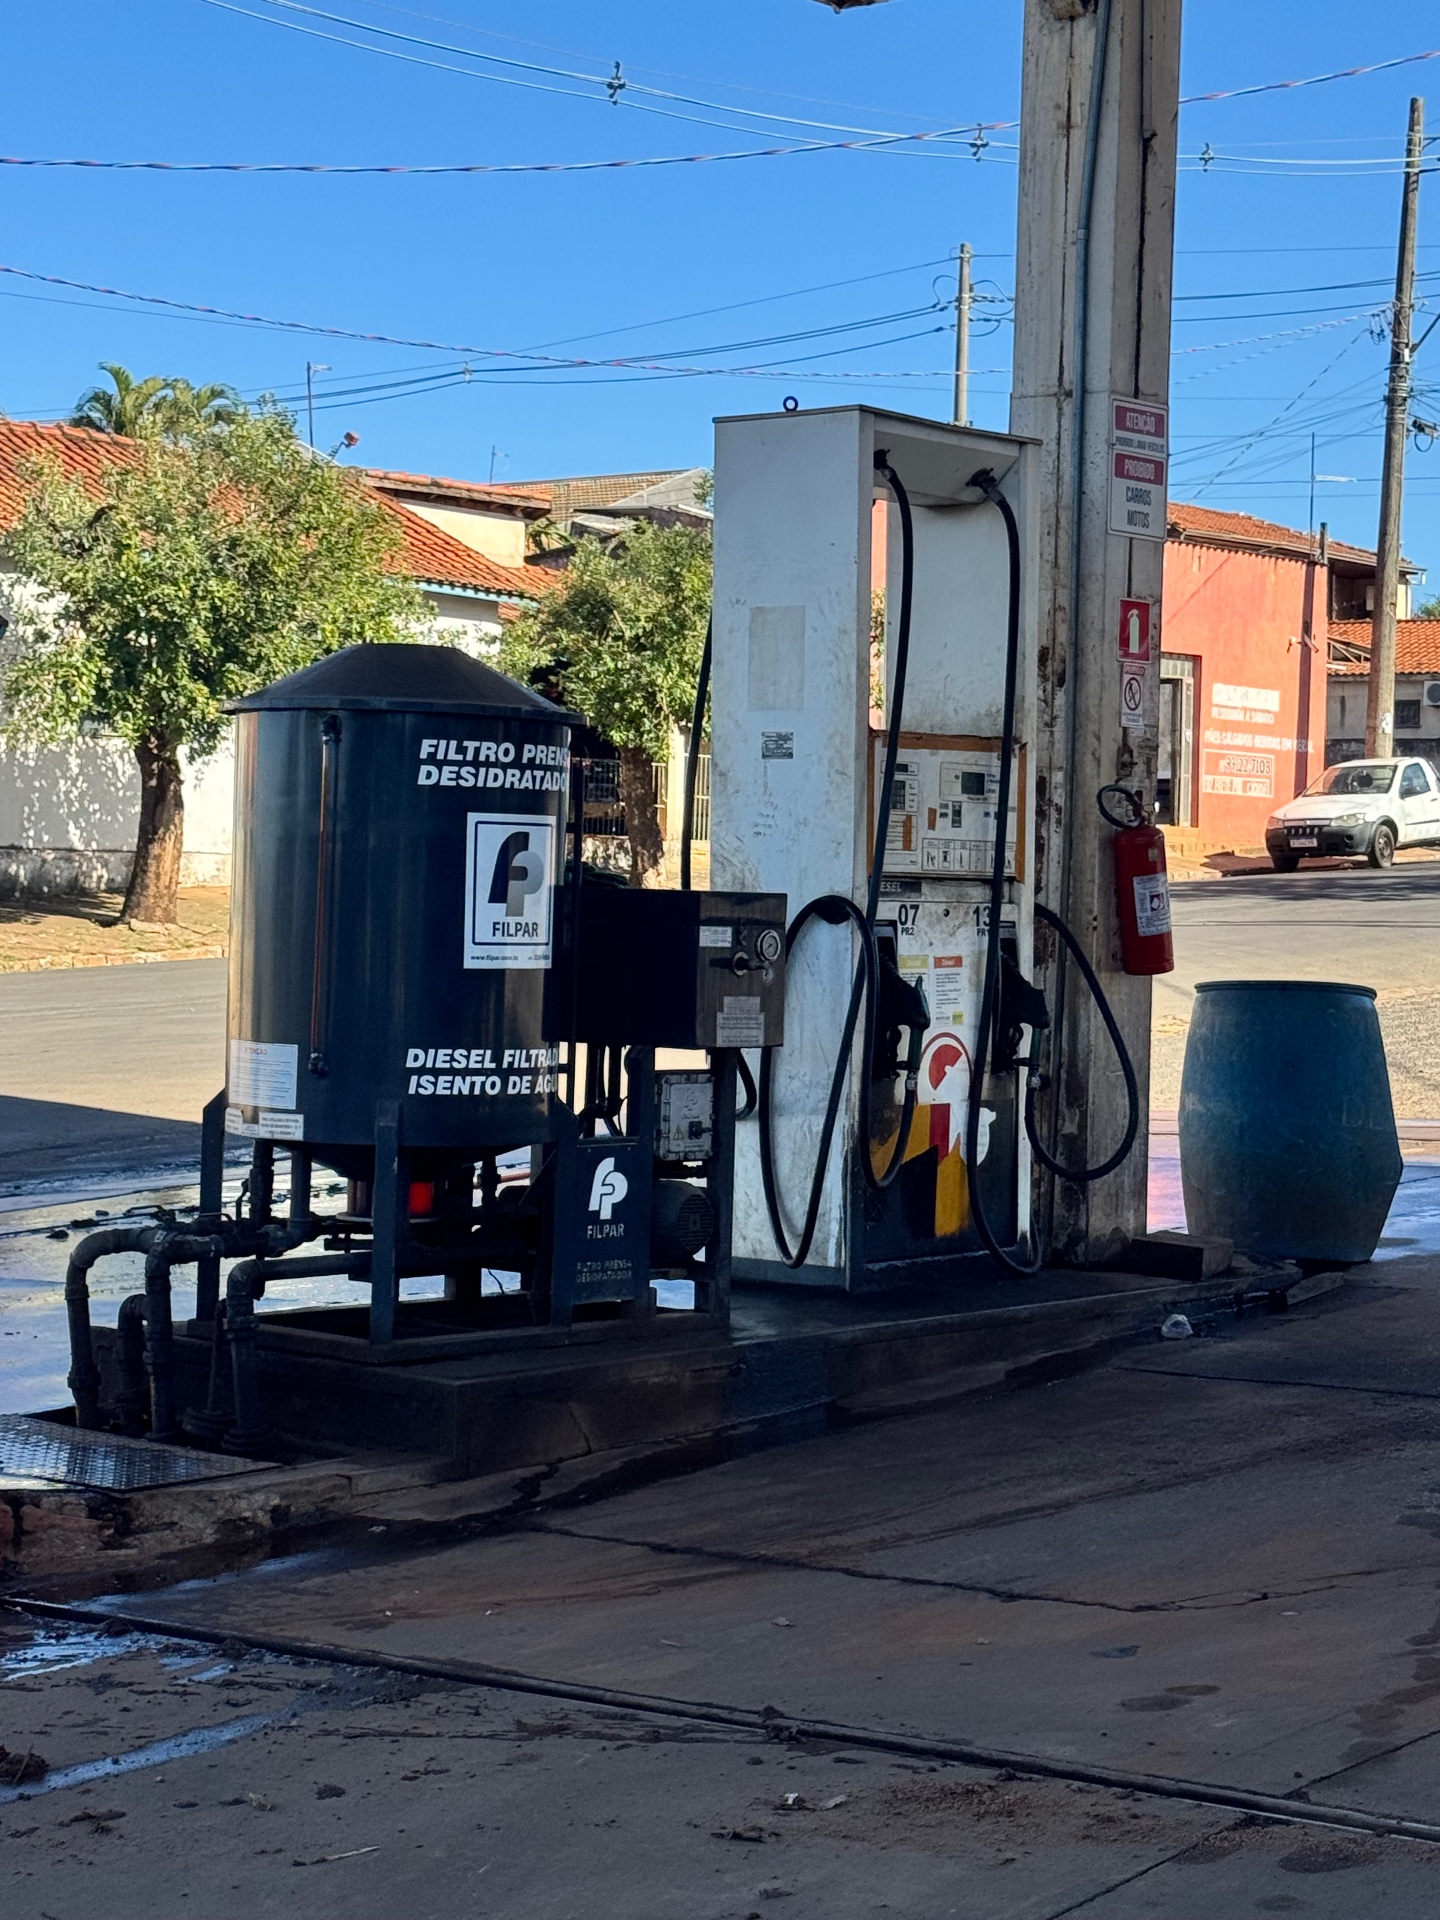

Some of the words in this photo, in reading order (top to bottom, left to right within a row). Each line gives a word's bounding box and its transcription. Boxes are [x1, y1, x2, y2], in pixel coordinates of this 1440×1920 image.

[1125, 410, 1156, 435] ATENÇÃO
[1124, 459, 1155, 480] PROIBIDO
[1125, 485, 1152, 507] CARROS
[1126, 508, 1150, 529] MOTOS
[419, 739, 516, 763] FILTRO
[417, 765, 568, 792] DESIDRATADO
[880, 882, 902, 892] ESEL
[898, 903, 920, 927] 07
[491, 921, 539, 939] FILPAR
[901, 926, 915, 936] PR2
[405, 1048, 497, 1069] DIESEL
[408, 1074, 502, 1096] ISENTO
[507, 1075, 532, 1095] DE
[587, 1223, 625, 1239] FILPAR
